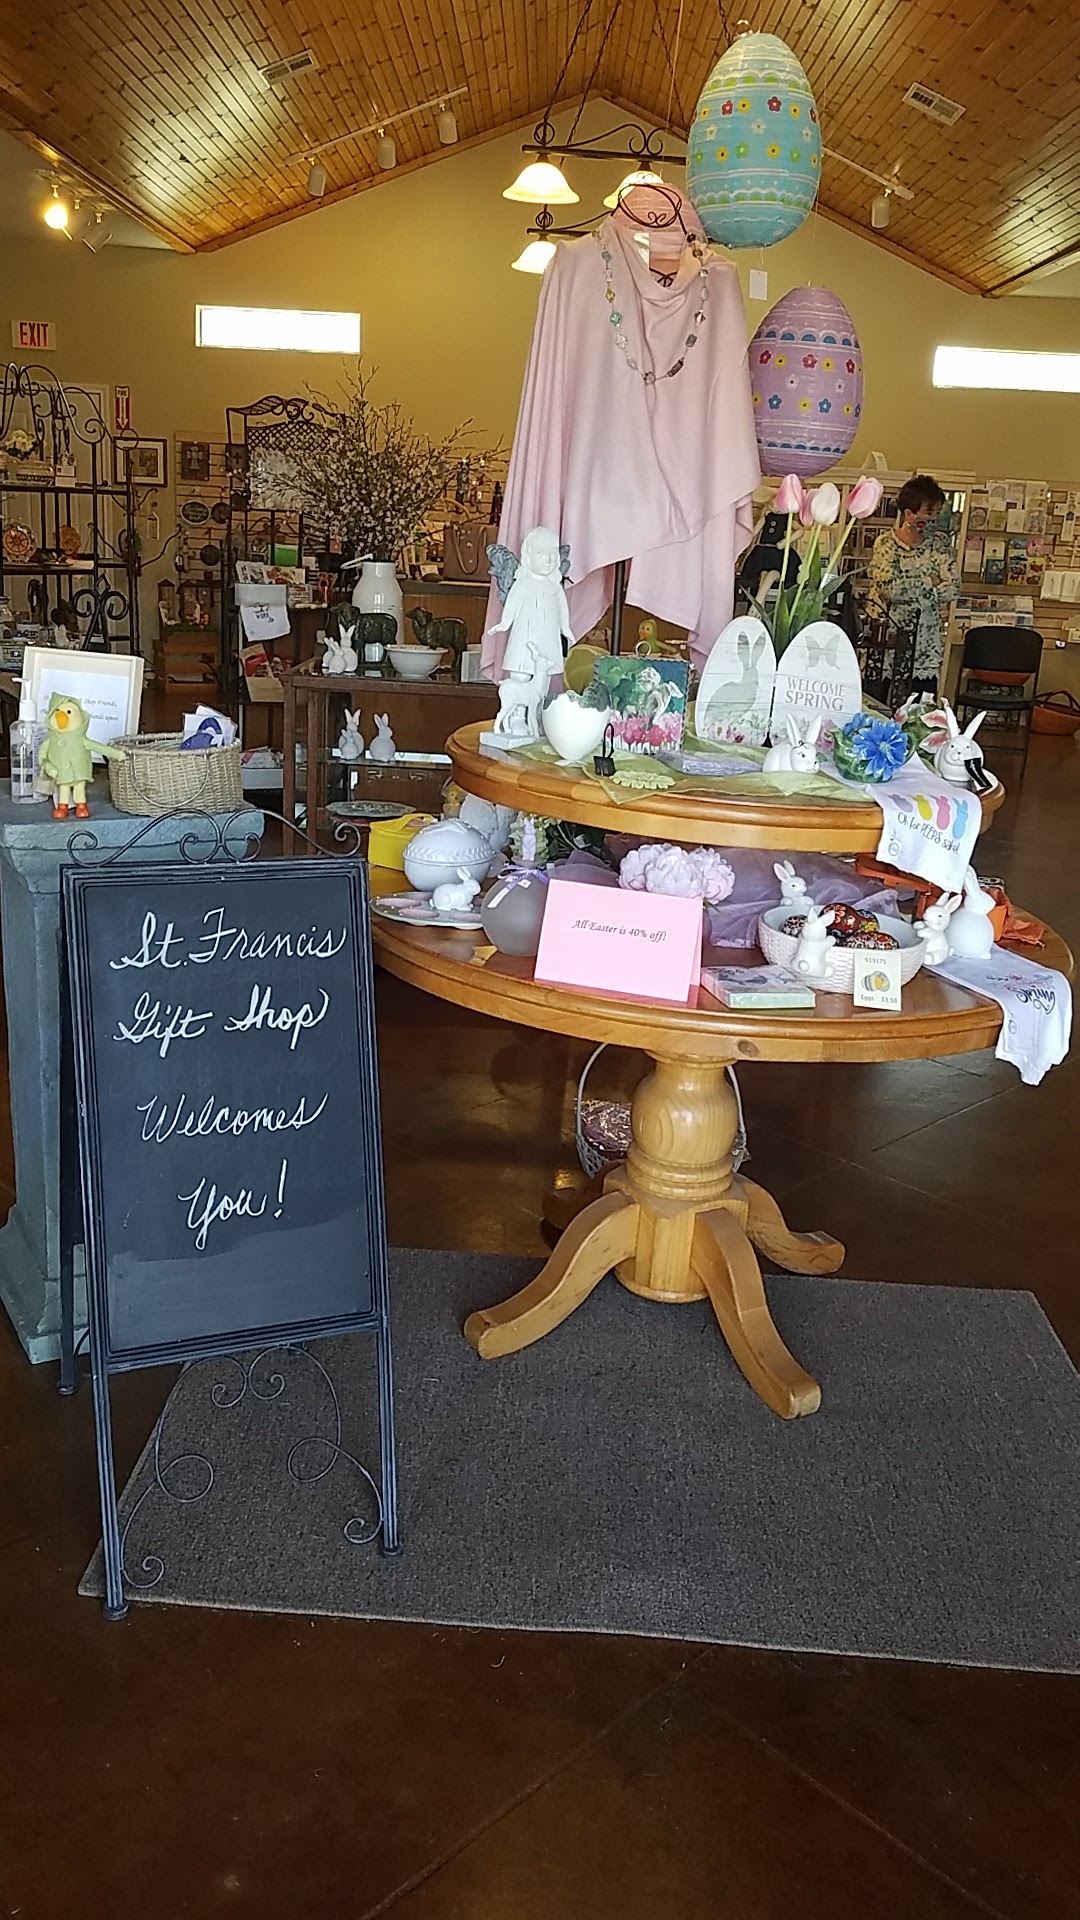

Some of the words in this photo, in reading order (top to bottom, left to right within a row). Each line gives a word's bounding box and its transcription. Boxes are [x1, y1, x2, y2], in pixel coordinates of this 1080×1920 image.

[19, 321, 49, 347] EXIT
[787, 676, 846, 697] WELCOME
[785, 690, 844, 712] SPRING
[109, 911, 188, 970] St.
[188, 907, 347, 964] Francis
[571, 920, 588, 929] All
[589, 922, 618, 933] Easter
[618, 925, 627, 935] is
[628, 928, 647, 938] 40%
[649, 930, 667, 943] off!
[860, 994, 875, 1003] Eggs
[880, 996, 898, 1004] $3.50
[1007, 985, 1056, 1015] Spring
[112, 991, 213, 1059] Gift
[223, 983, 330, 1050] Shop
[136, 1093, 329, 1143] Welcomes
